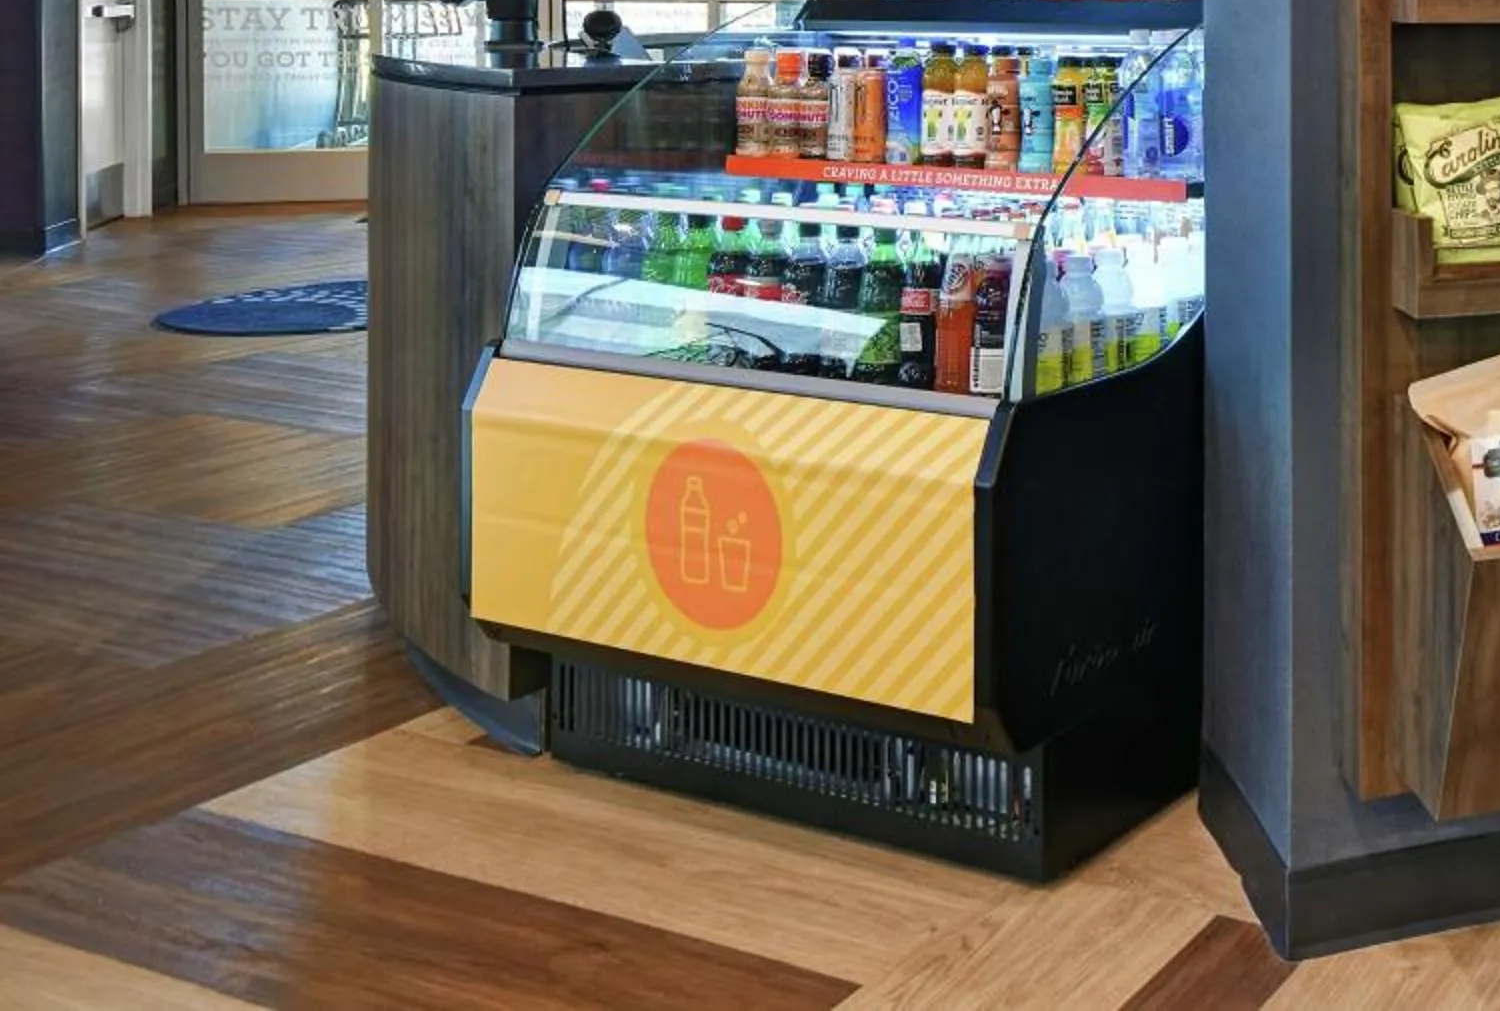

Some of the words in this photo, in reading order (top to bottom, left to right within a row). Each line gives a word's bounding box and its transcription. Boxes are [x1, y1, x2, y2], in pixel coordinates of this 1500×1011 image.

[202, 7, 291, 31] STAY
[203, 51, 248, 68] OU
[257, 51, 311, 68] GOT
[823, 166, 876, 180] CRAVING
[880, 169, 889, 181] A
[891, 169, 933, 184] LITTLE
[936, 174, 1012, 189] SOMETHING
